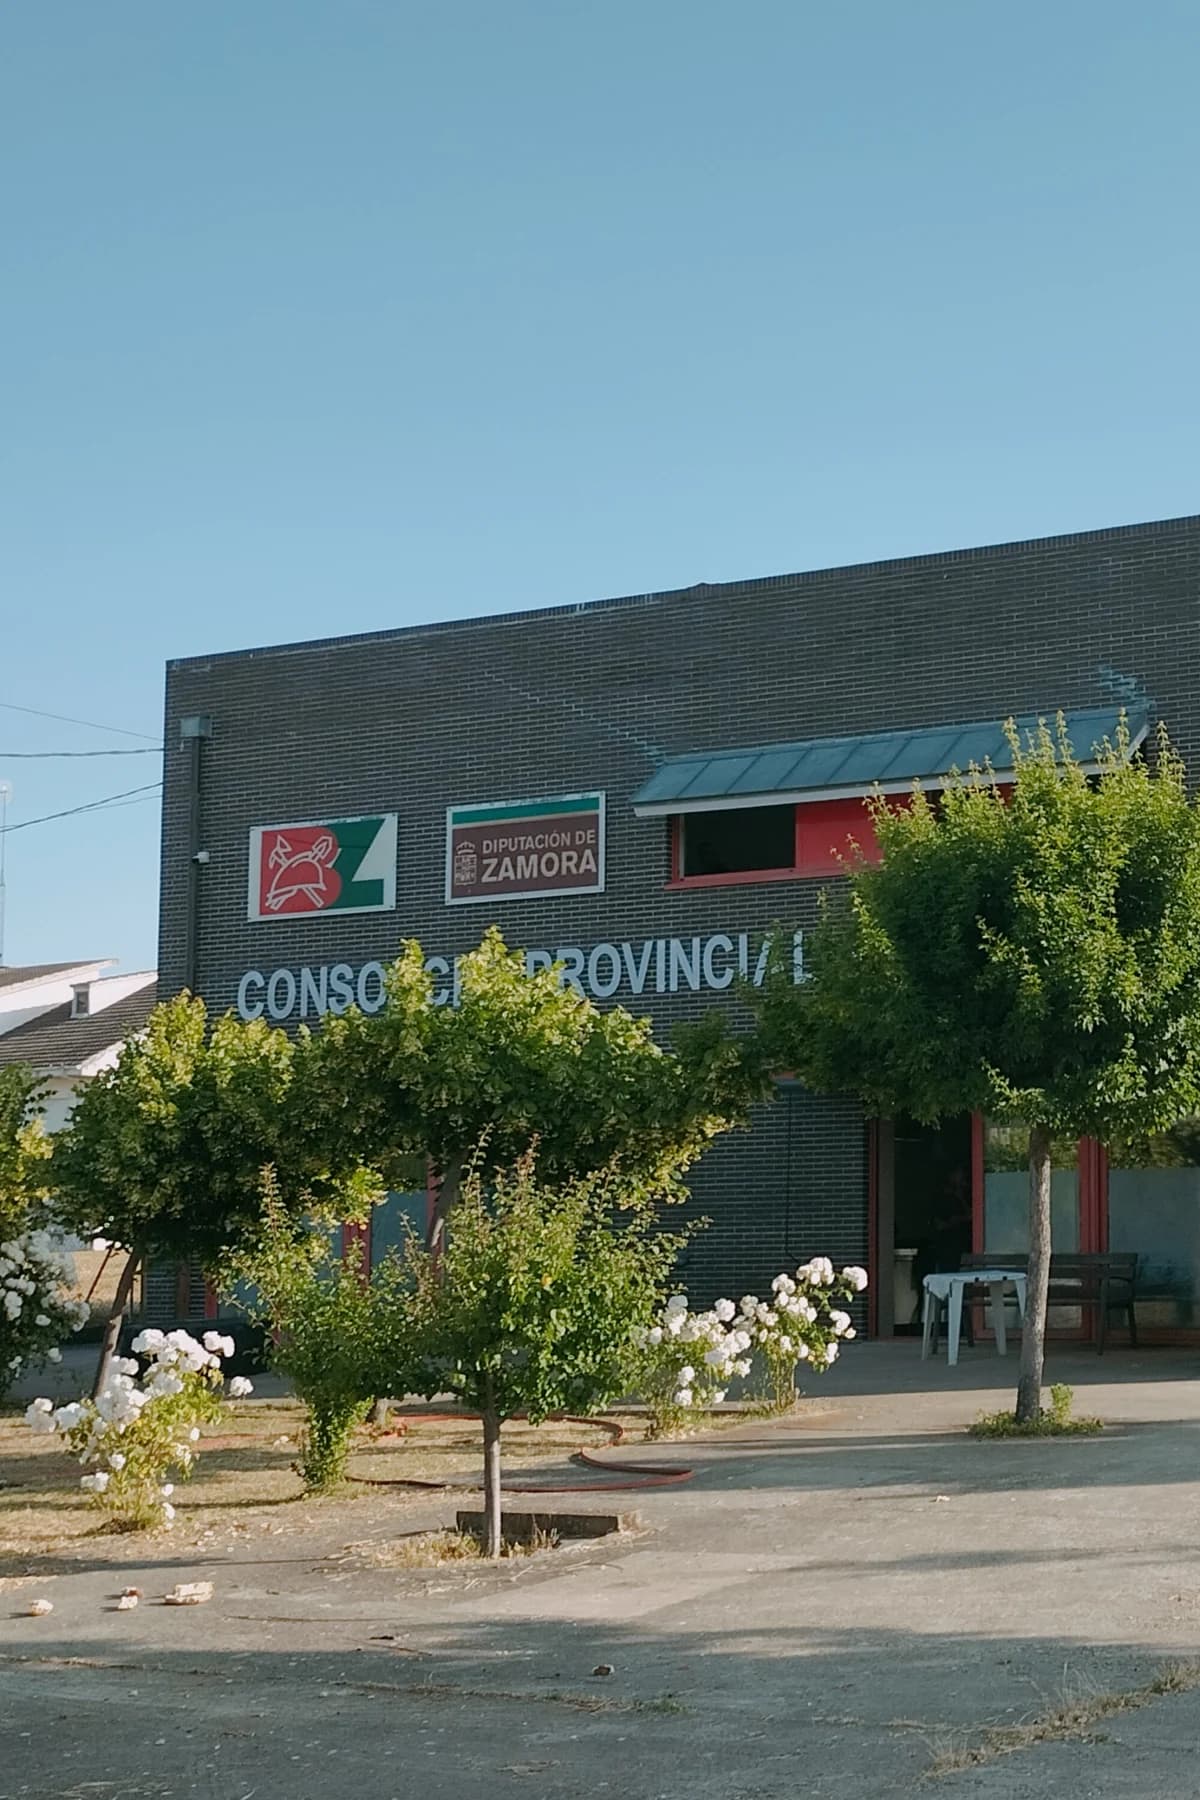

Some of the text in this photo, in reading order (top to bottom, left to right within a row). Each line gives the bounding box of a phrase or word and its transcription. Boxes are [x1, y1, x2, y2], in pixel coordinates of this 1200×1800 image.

[482, 829, 596, 855] DIPUTACIÓN DE
[481, 848, 597, 883] ZAMORA
[238, 956, 496, 1020] CONSOCI
